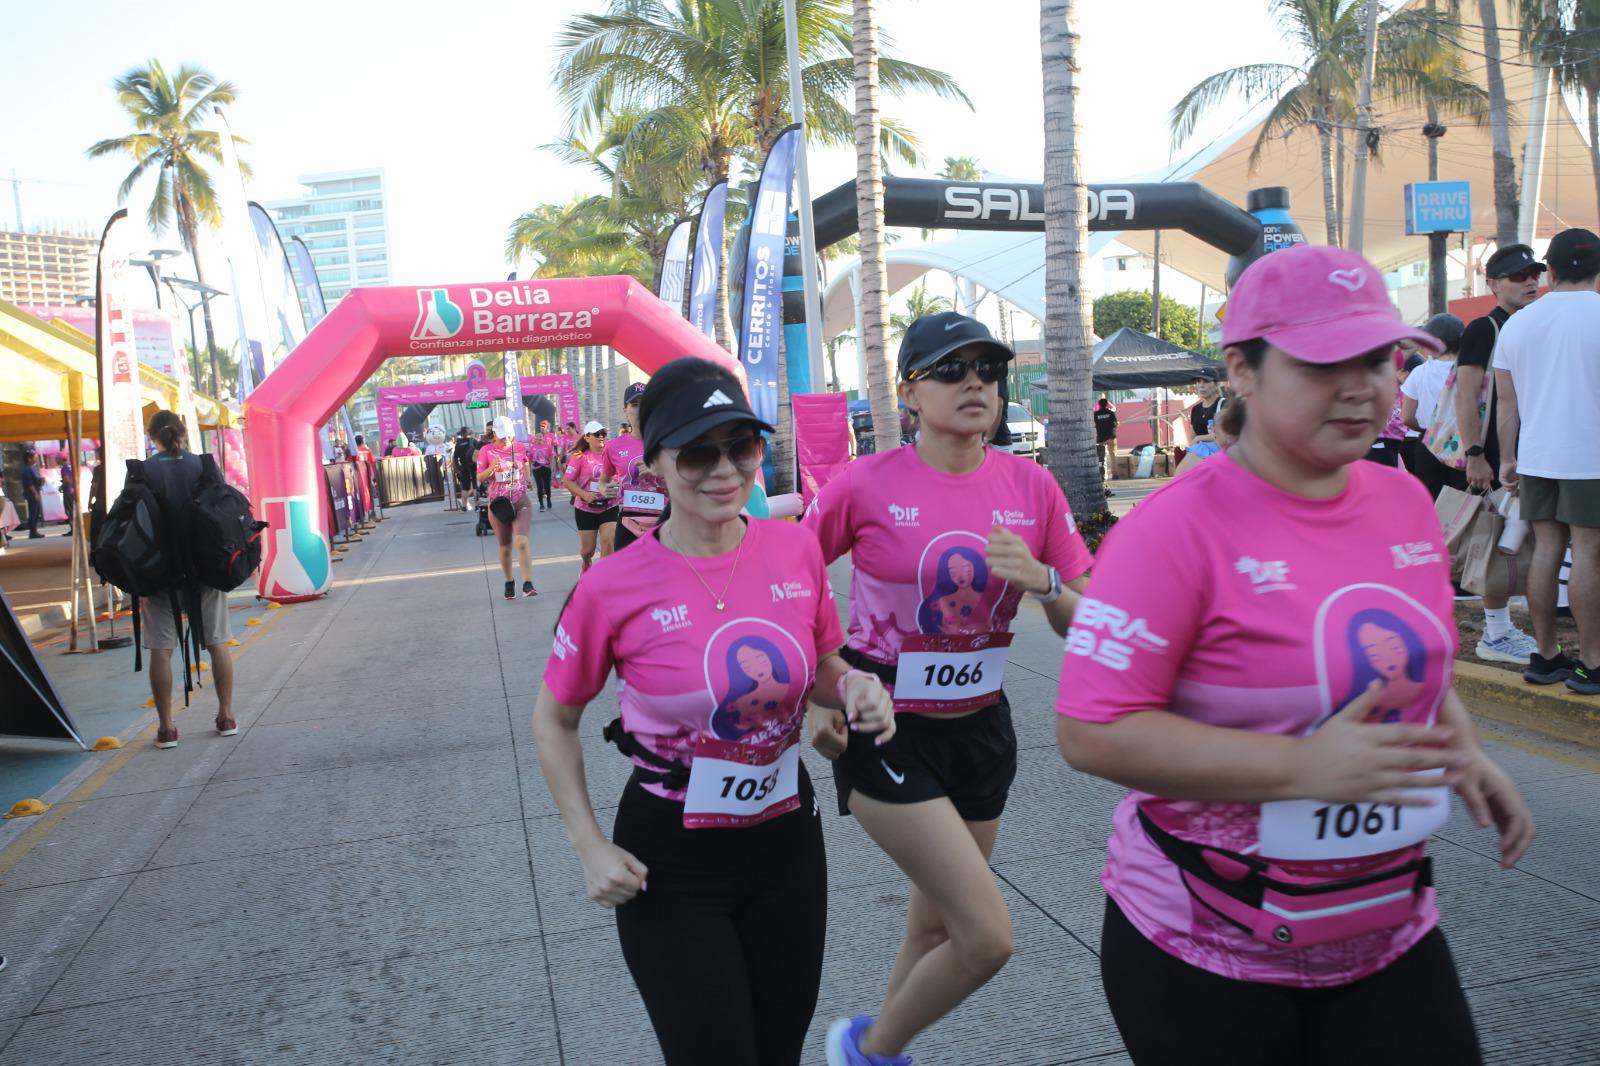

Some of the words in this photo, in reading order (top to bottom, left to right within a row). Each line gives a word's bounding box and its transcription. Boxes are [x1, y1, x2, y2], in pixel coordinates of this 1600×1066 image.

[1419, 192, 1468, 206] DRIVE
[1421, 208, 1467, 221] THRU
[1263, 234, 1304, 244] POWER
[469, 285, 551, 308] Delia
[747, 246, 771, 365] CERRITOS
[409, 340, 474, 350] Confianza
[476, 338, 504, 347] para
[507, 335, 519, 344] tu
[521, 331, 592, 344] diagnóstico
[631, 494, 656, 504] 0583
[895, 506, 920, 522] DIF
[658, 604, 689, 626] DIF
[924, 661, 983, 687] 1066
[719, 768, 779, 801] 1058
[1313, 803, 1402, 840] 1061
